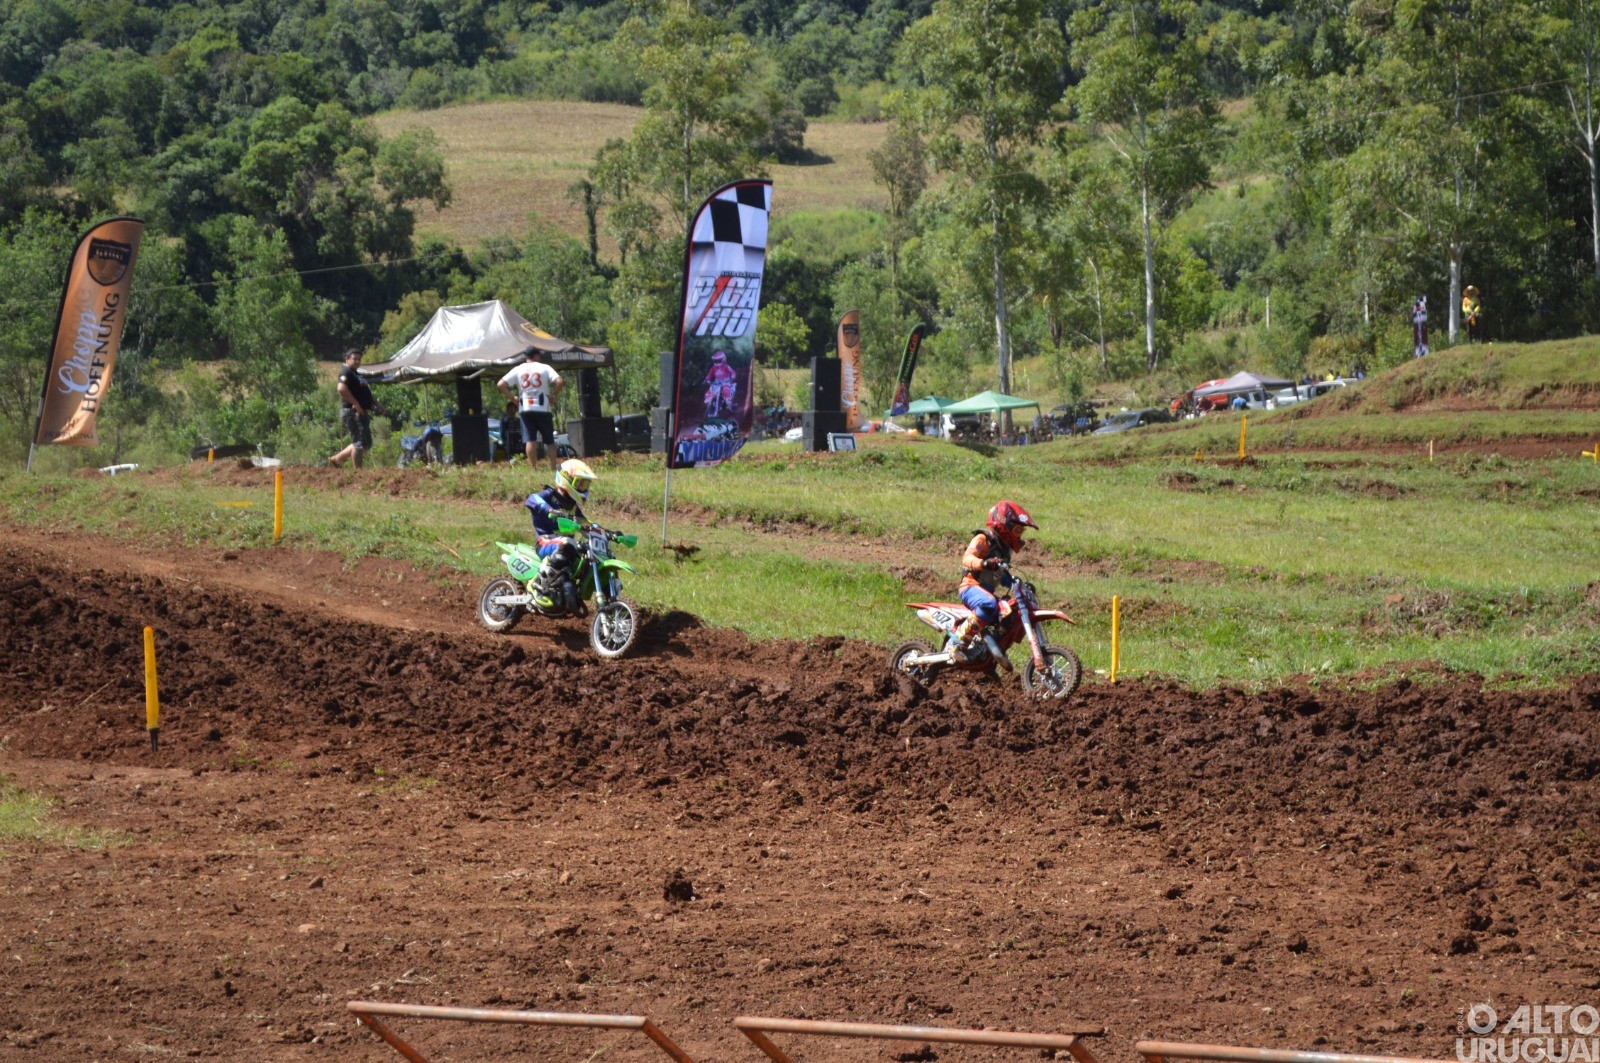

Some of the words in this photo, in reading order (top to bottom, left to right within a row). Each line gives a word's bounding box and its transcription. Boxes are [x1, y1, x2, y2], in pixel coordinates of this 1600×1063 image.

[58, 311, 107, 394] Chopp
[81, 293, 119, 412] HOFFNUNG
[520, 372, 542, 389] 33
[511, 557, 532, 574] 007
[931, 611, 951, 624] 007
